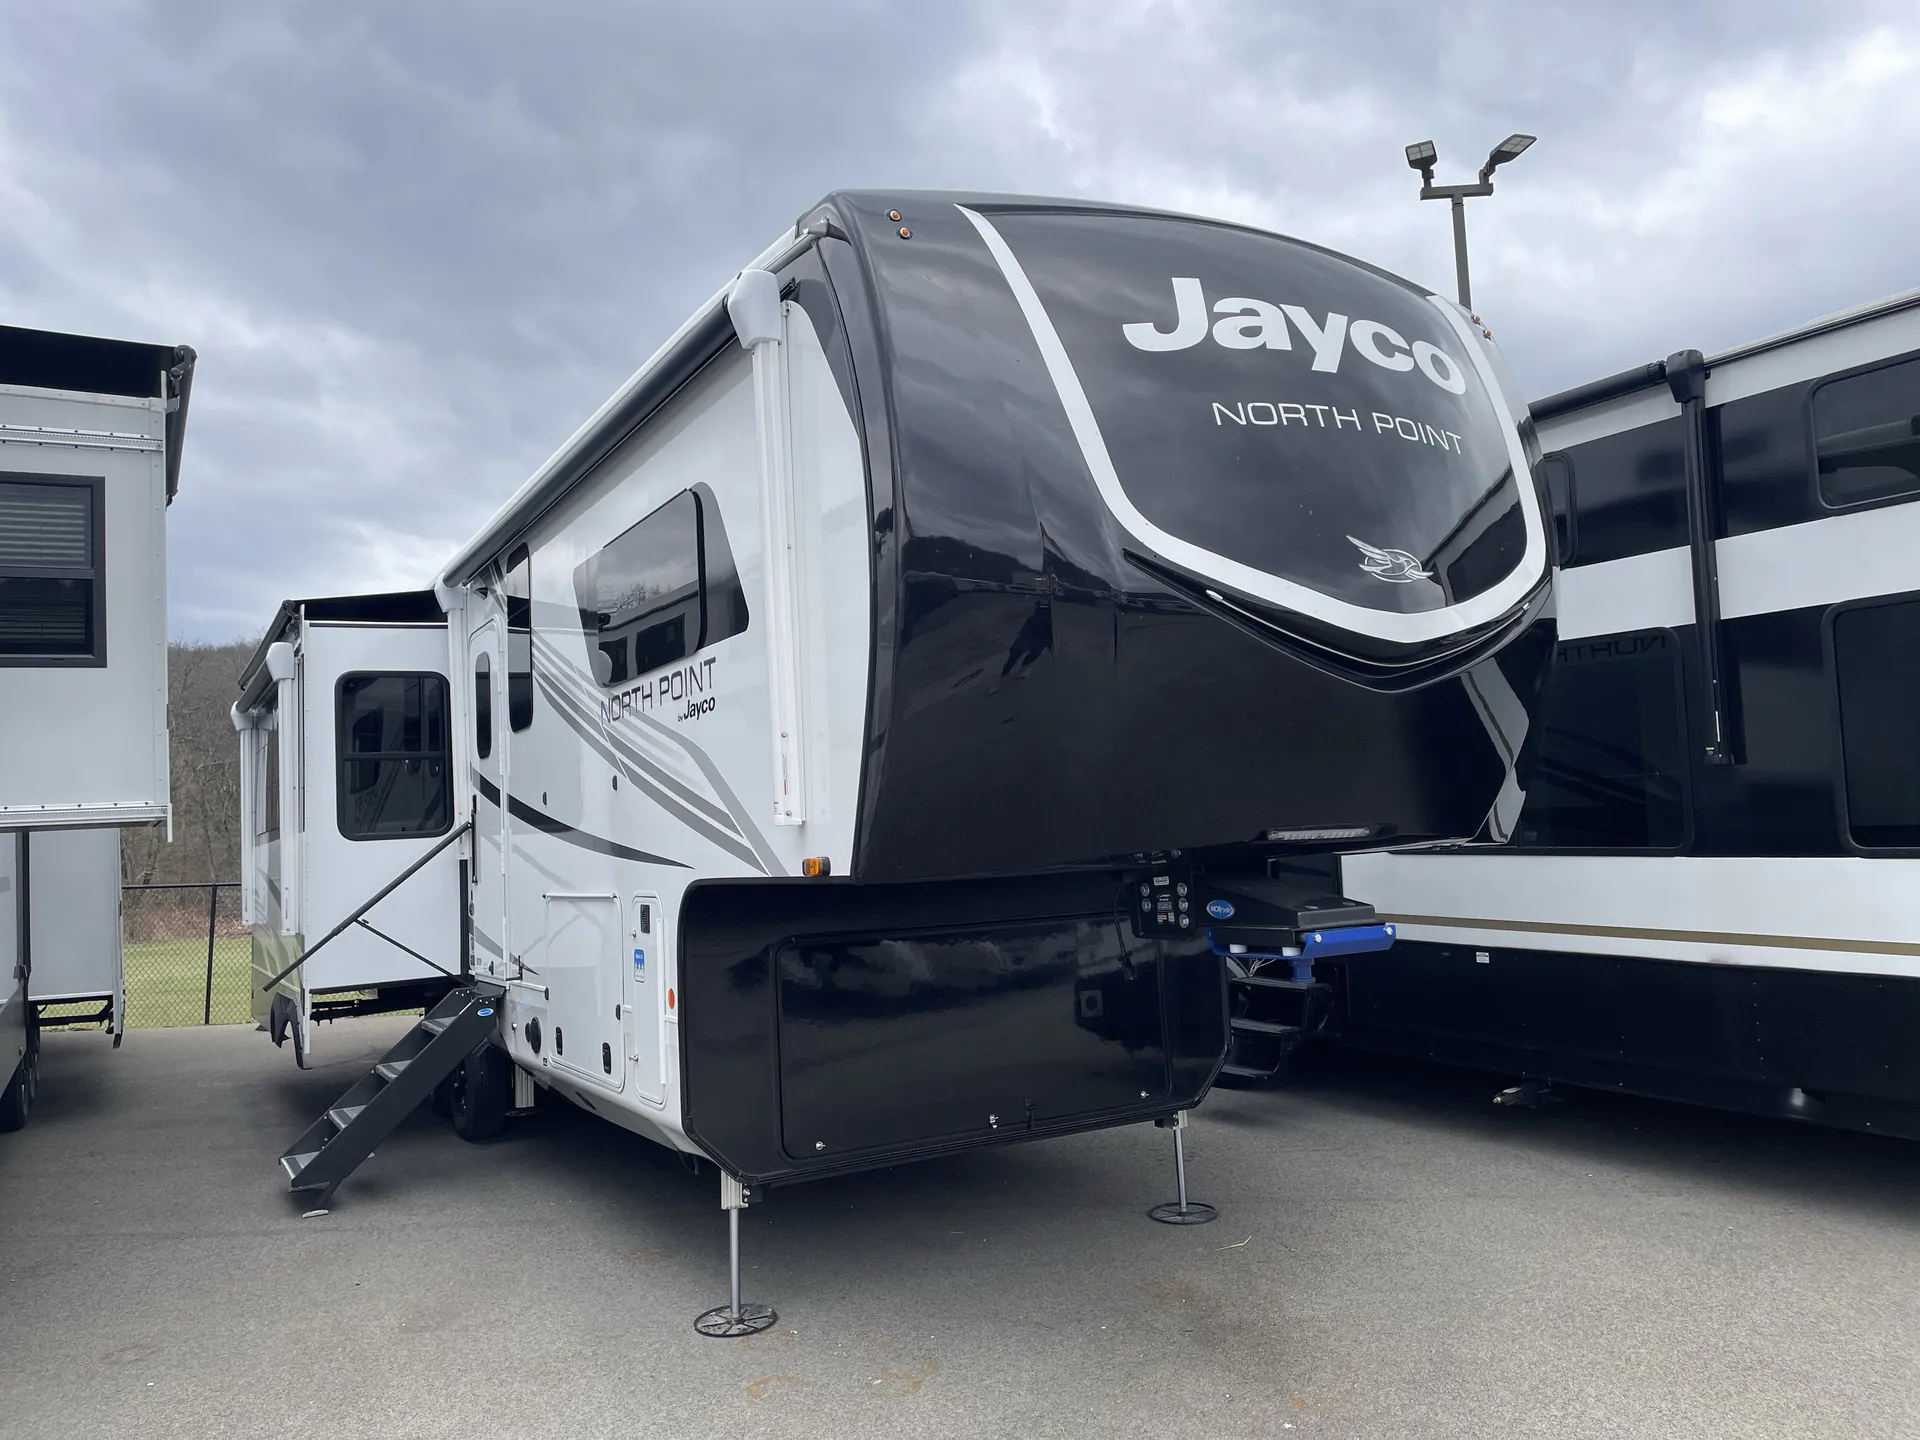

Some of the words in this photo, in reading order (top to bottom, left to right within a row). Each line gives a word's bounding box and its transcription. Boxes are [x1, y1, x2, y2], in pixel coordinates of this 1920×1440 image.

[1122, 277, 1466, 395] Jayco
[1213, 402, 1361, 431] NORTH
[1372, 412, 1461, 455] POINT
[601, 681, 653, 725] NORTH
[659, 656, 716, 706] POINT
[684, 697, 716, 720] Jayco
